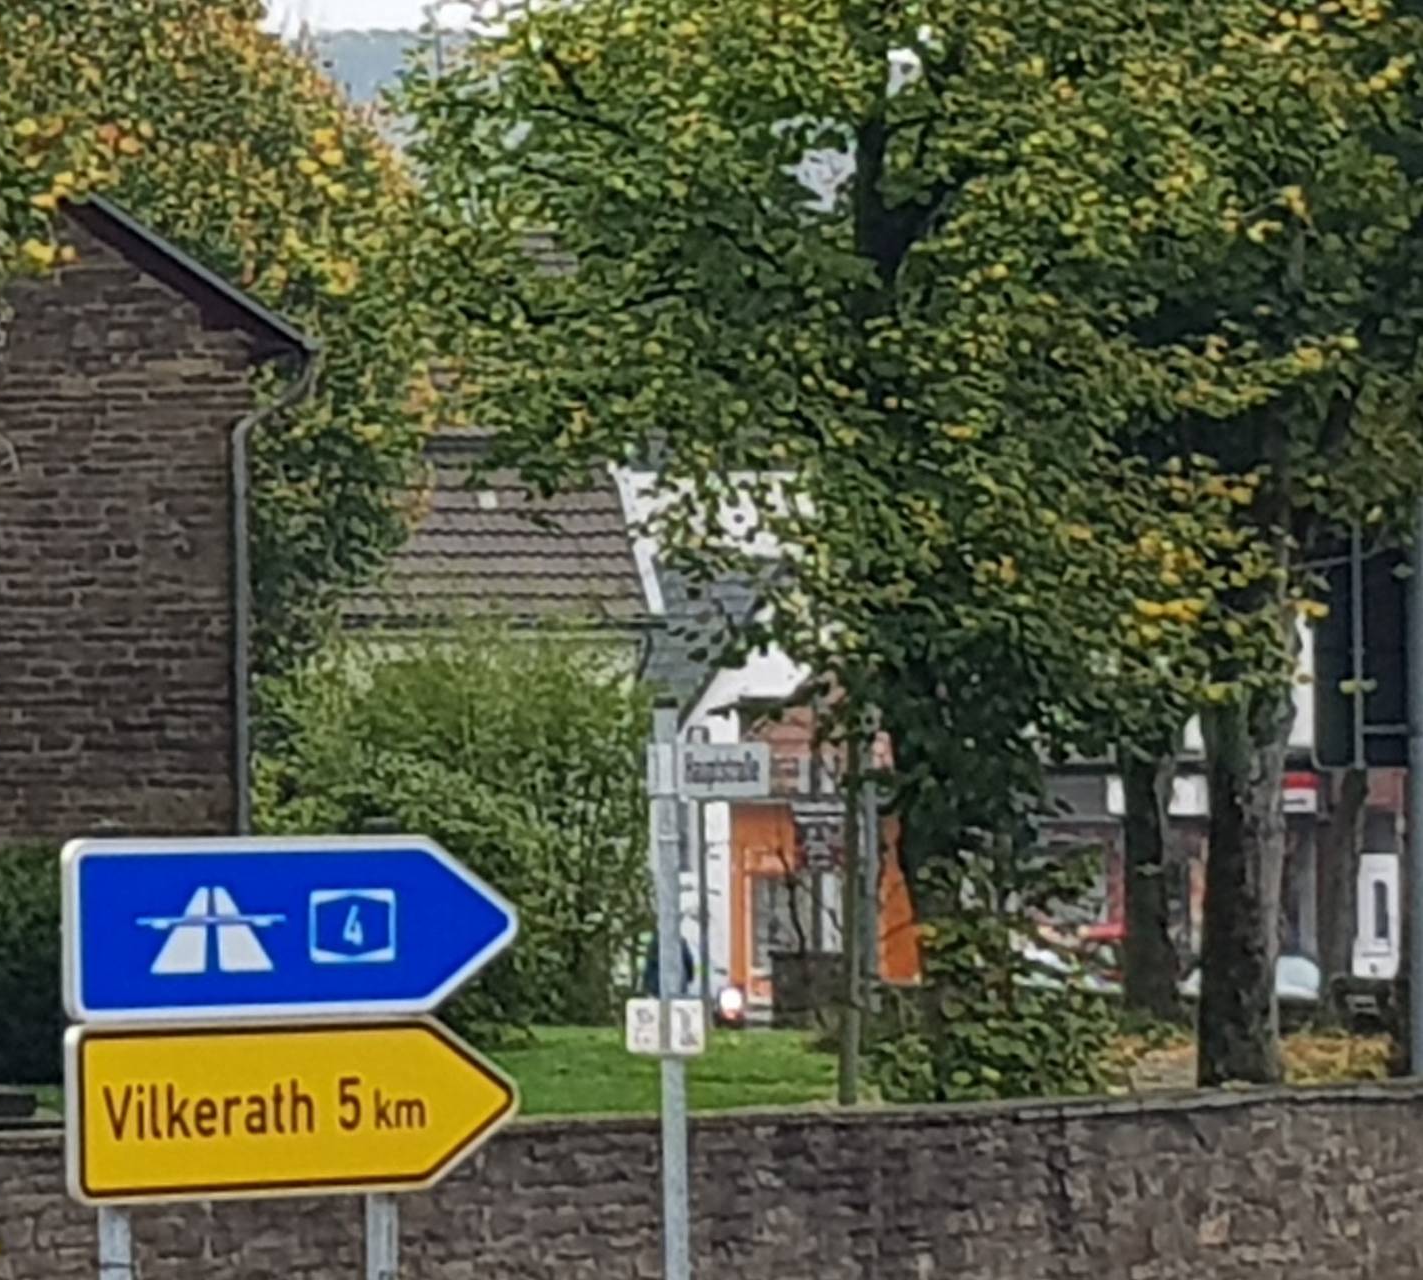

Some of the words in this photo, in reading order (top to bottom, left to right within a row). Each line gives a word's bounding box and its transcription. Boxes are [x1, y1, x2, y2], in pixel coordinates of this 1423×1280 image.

[343, 905, 364, 945] 4
[102, 1079, 315, 1141] Vilkerath
[338, 1076, 363, 1130] 5
[374, 1088, 427, 1130] km
